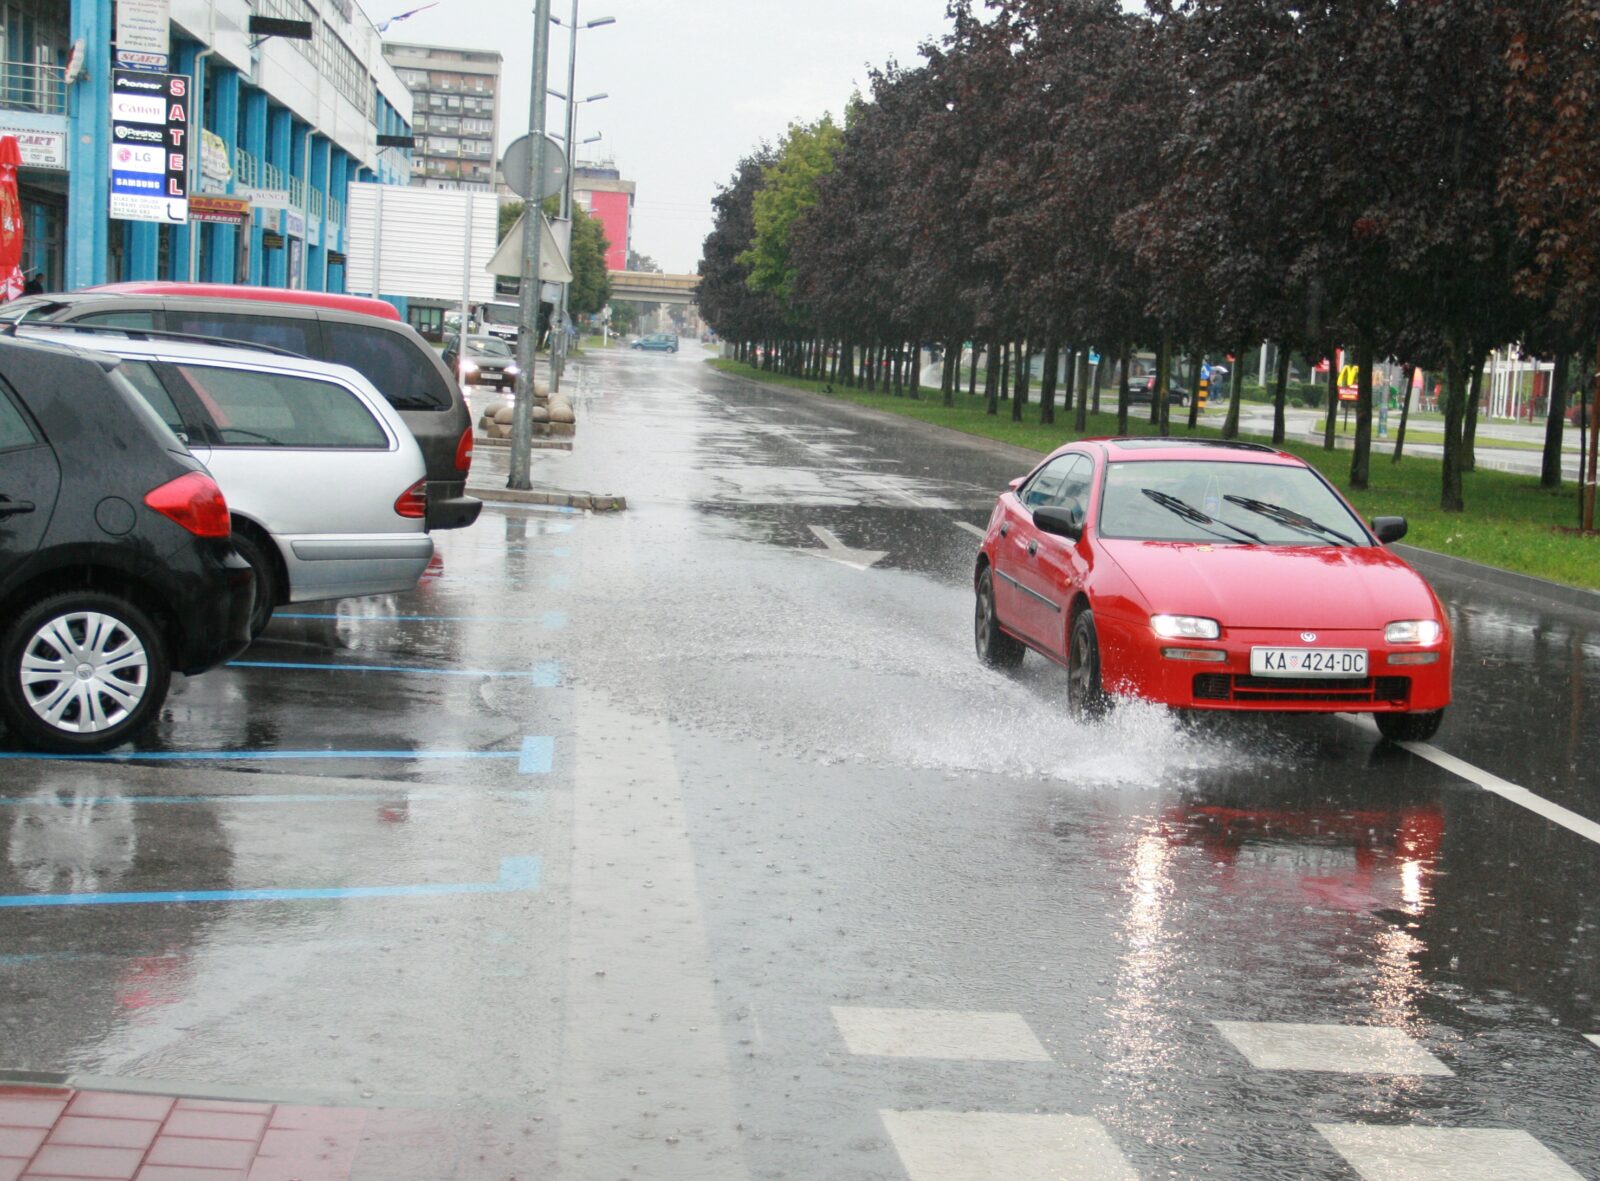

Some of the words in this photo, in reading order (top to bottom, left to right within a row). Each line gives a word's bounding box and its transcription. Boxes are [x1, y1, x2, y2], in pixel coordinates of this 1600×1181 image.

[121, 52, 163, 64] SCART
[118, 103, 160, 116] Canon
[14, 134, 56, 146] CART
[170, 79, 186, 195] SATEL
[134, 152, 152, 162] LG
[116, 178, 160, 189] SAMSUNG
[1265, 651, 1287, 671] KA
[1301, 652, 1364, 673] 424-DC
